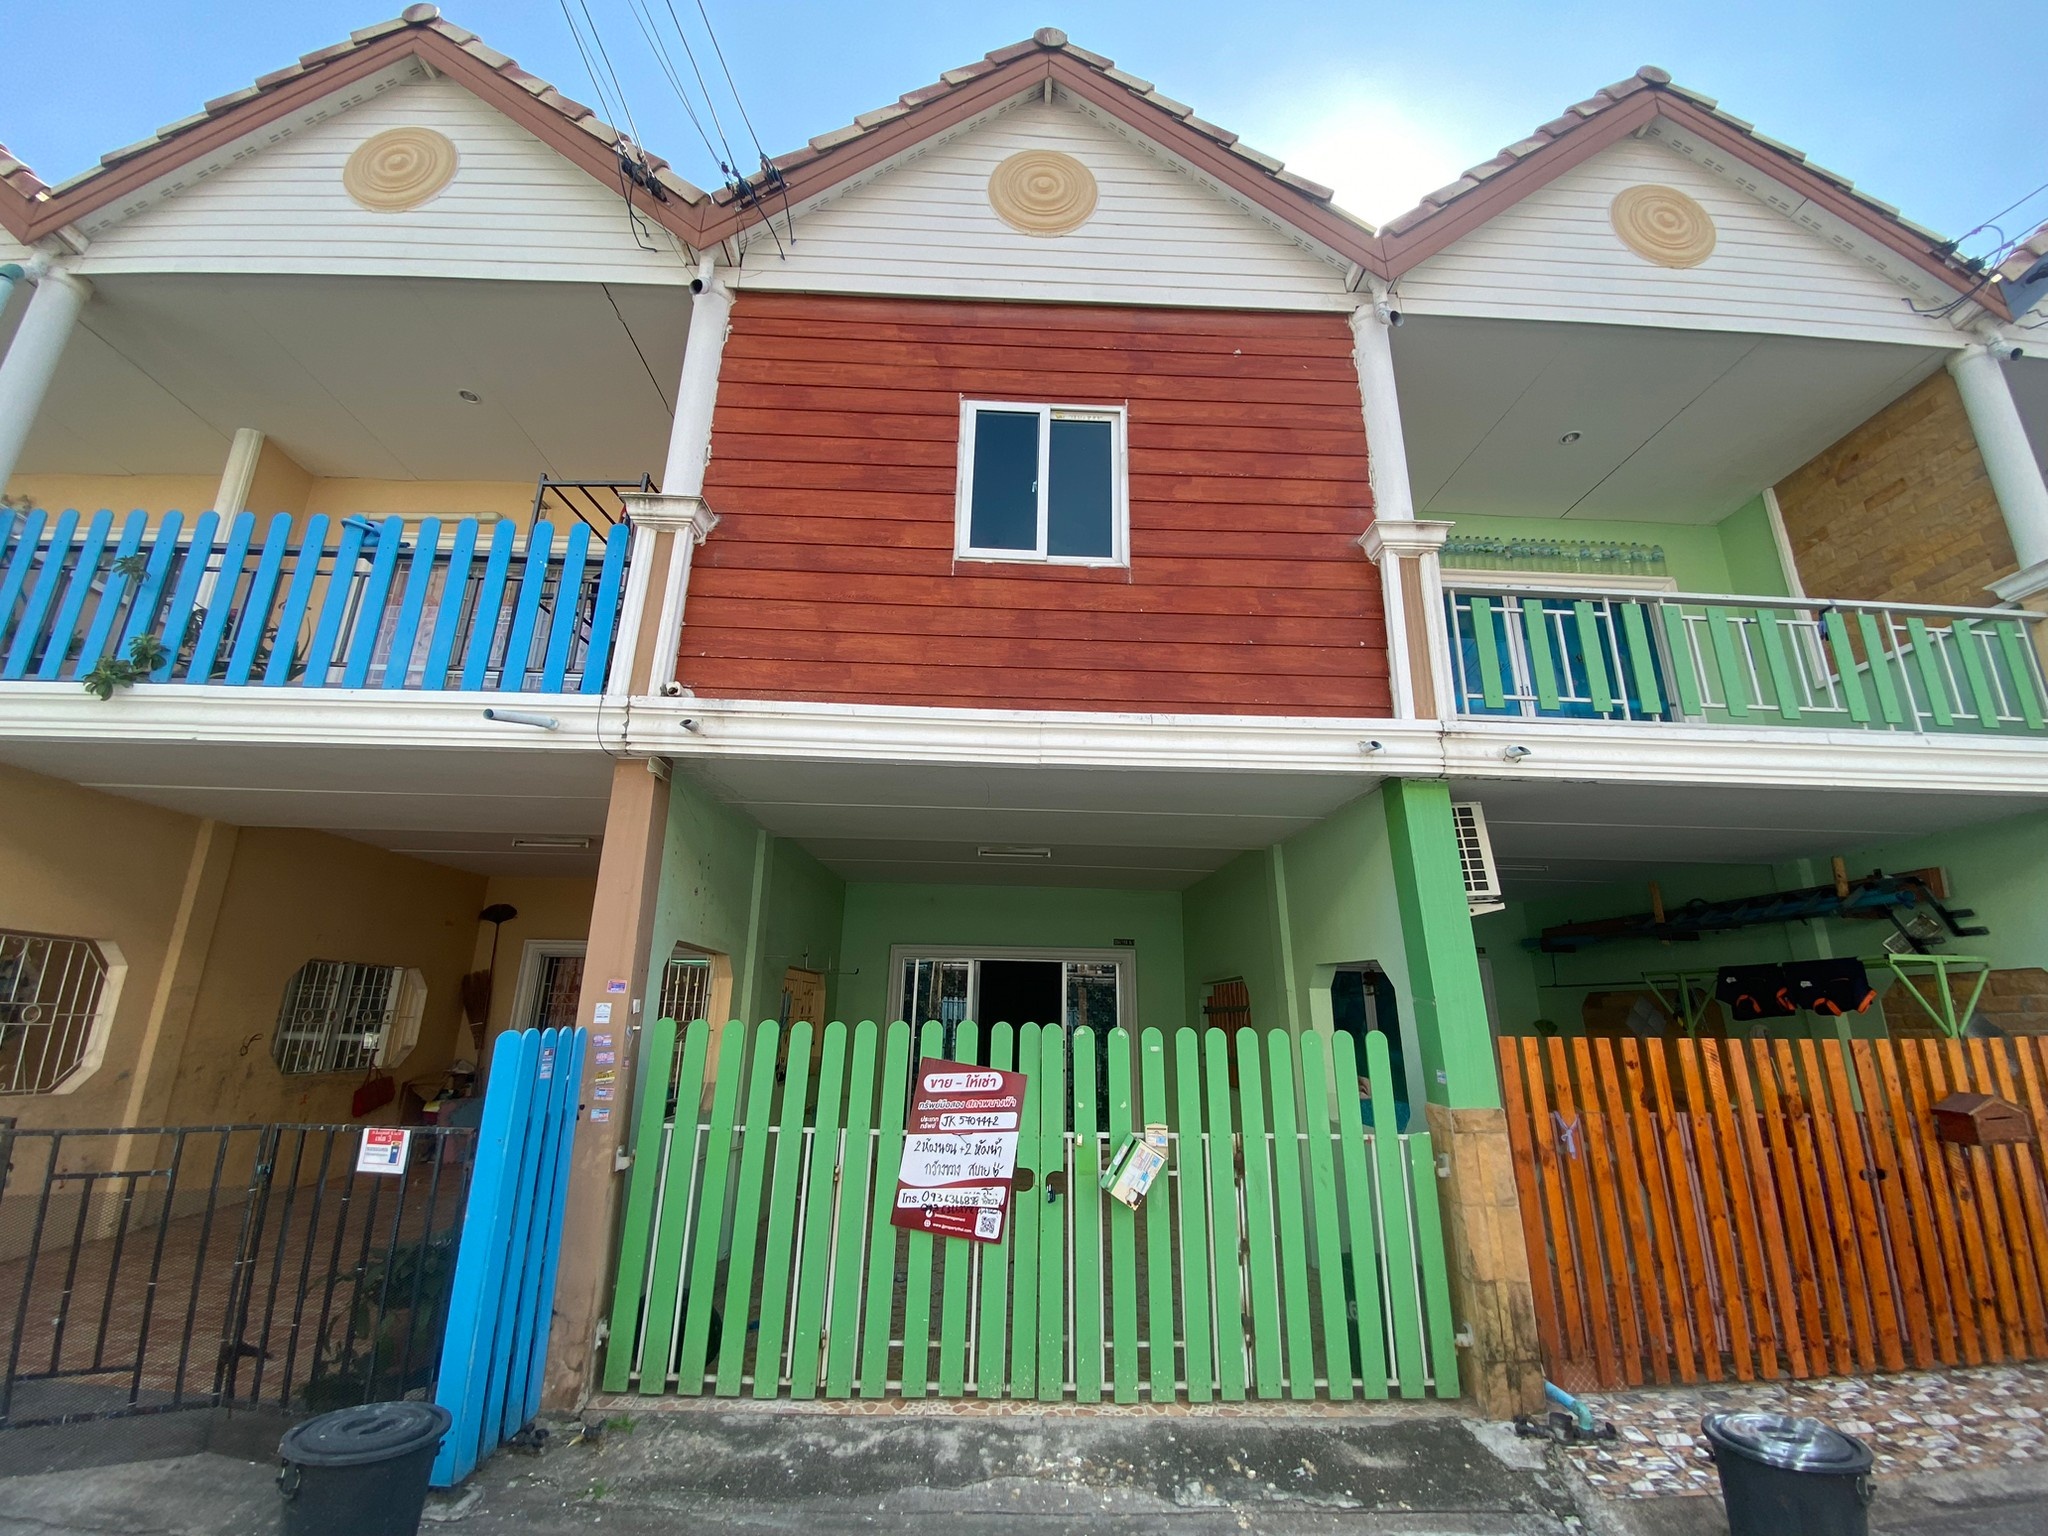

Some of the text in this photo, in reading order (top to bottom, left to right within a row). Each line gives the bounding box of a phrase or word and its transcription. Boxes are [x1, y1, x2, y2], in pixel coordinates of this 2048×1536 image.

[930, 1078, 953, 1089] ขาย
[965, 1074, 996, 1088] ให้เช่า
[918, 1099, 965, 1110] ทรัพย์มือสอง
[941, 1115, 956, 1127] JK
[902, 1192, 919, 1204] โทร.
